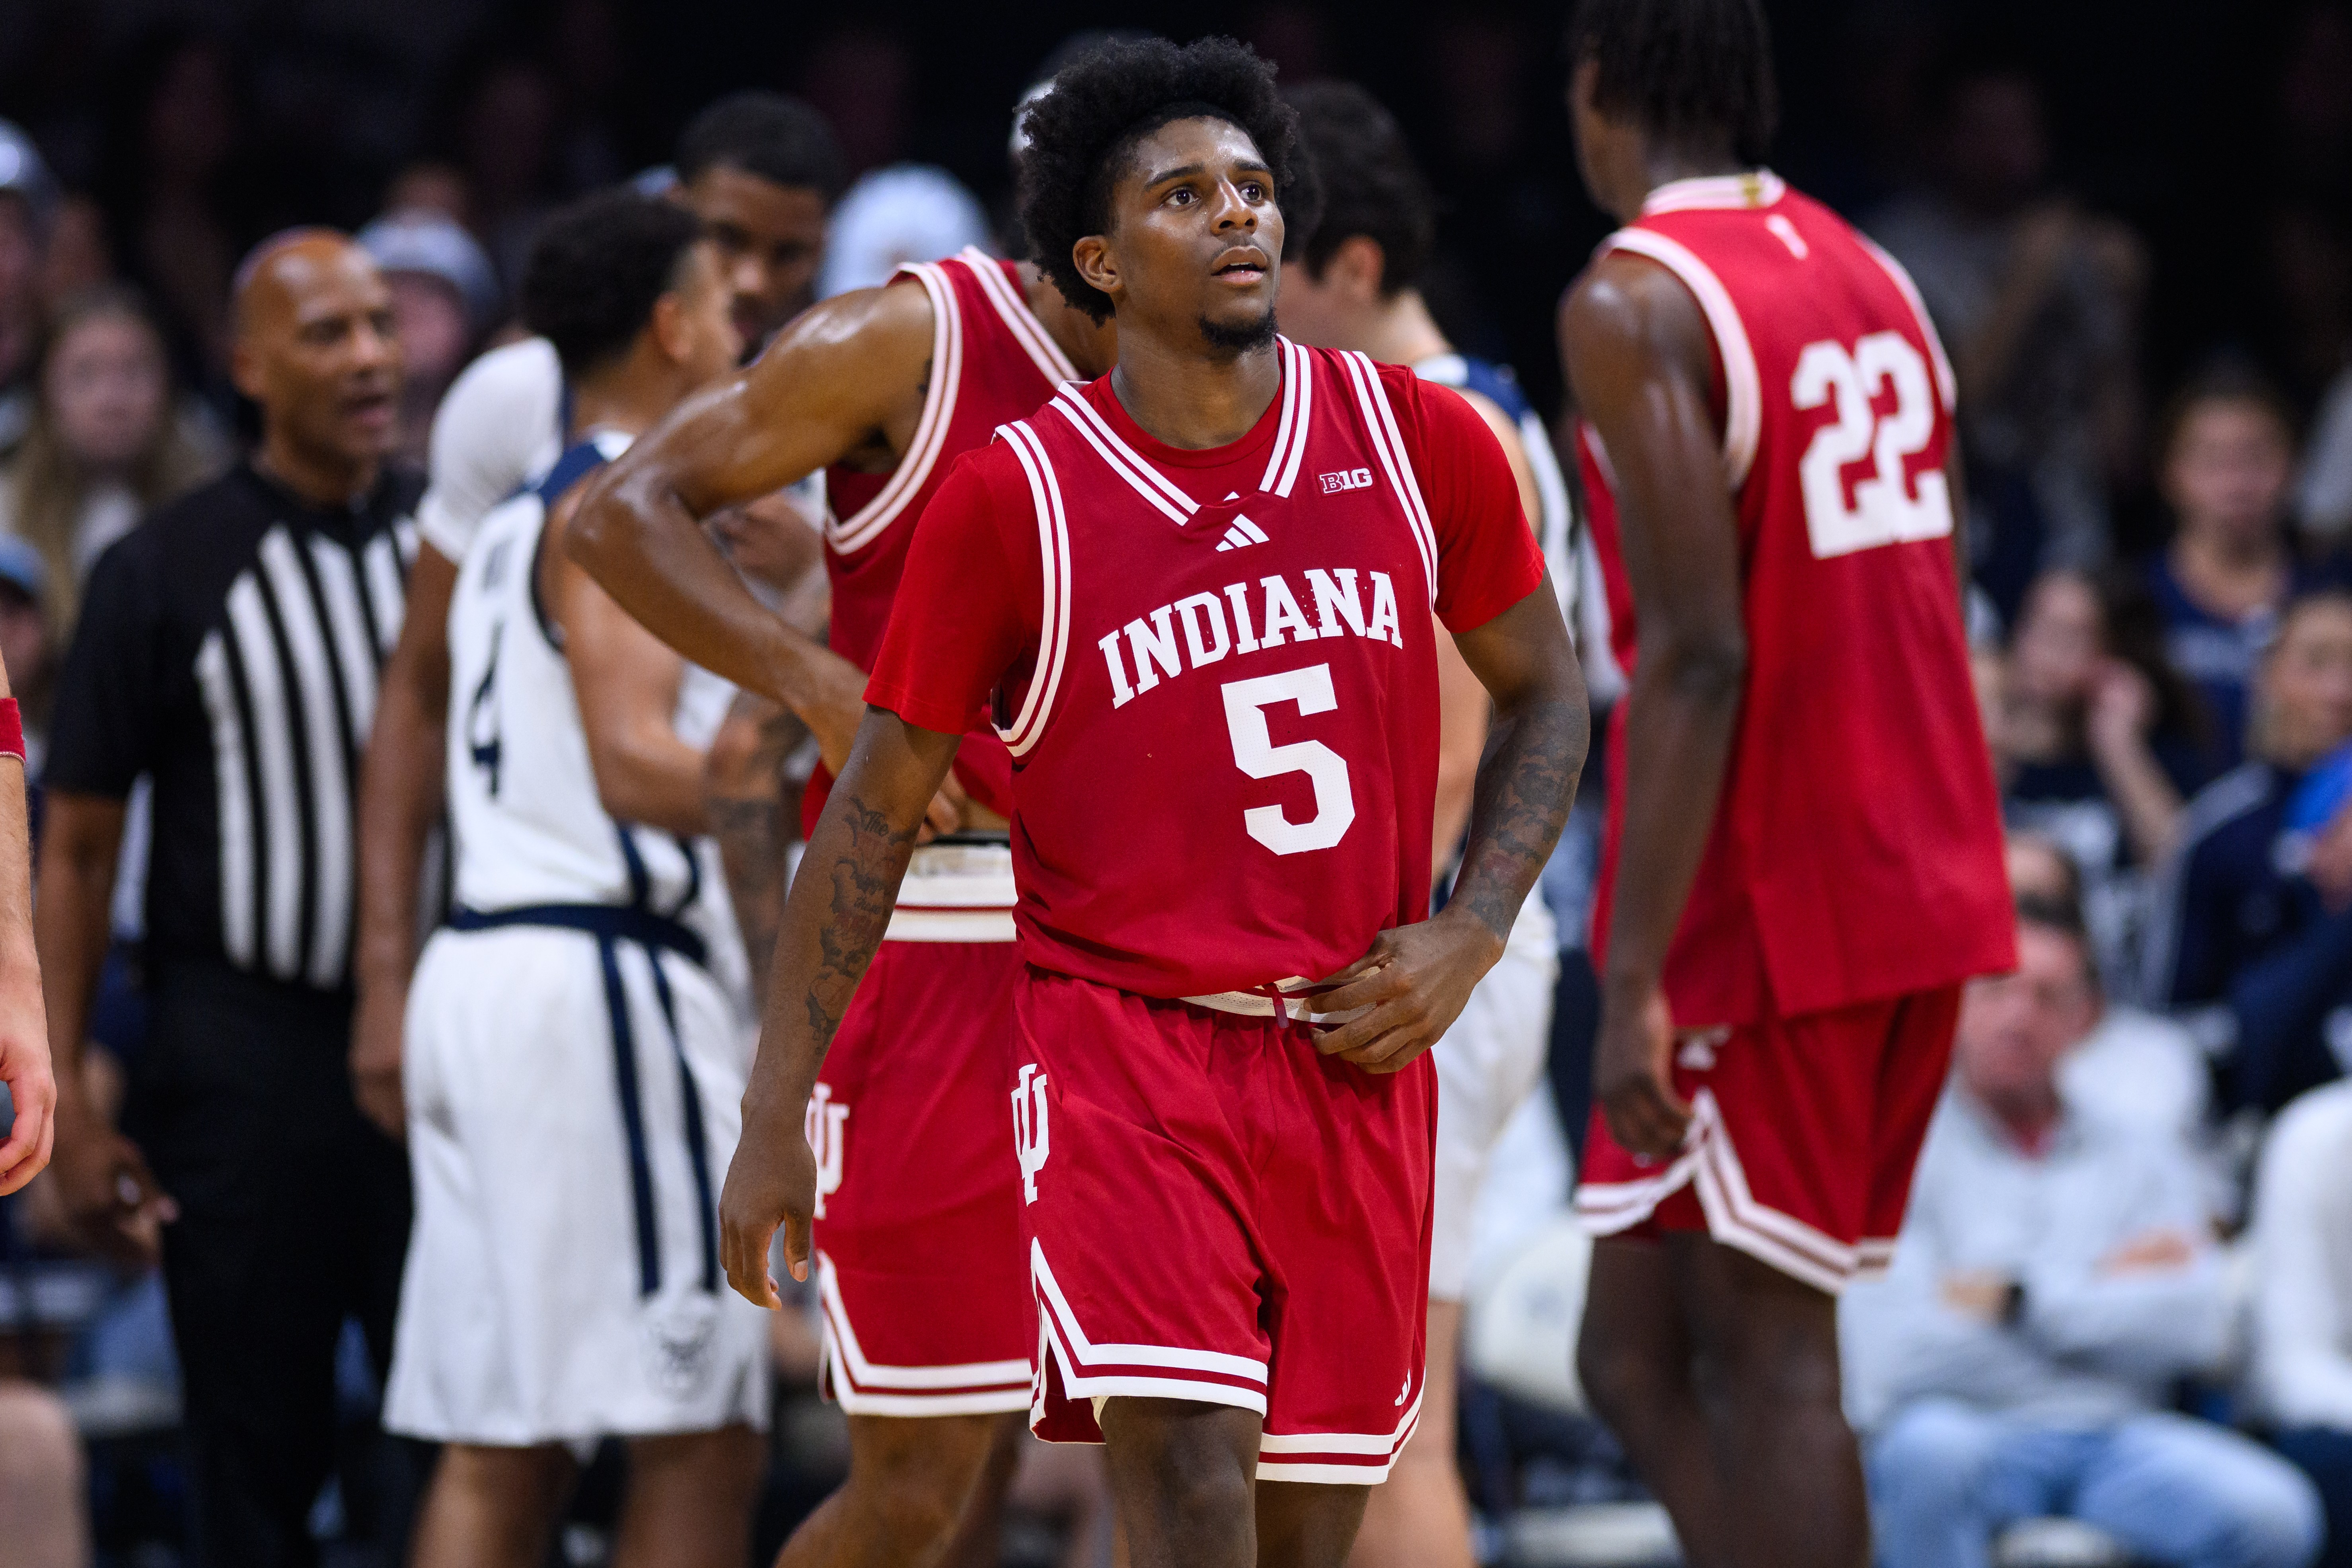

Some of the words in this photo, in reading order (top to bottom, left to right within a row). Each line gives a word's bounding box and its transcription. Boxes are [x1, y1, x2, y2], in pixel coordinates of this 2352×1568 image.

[1790, 330, 1954, 560] 22
[1098, 568, 1403, 709] INDIANA
[1221, 663, 1355, 856] 5
